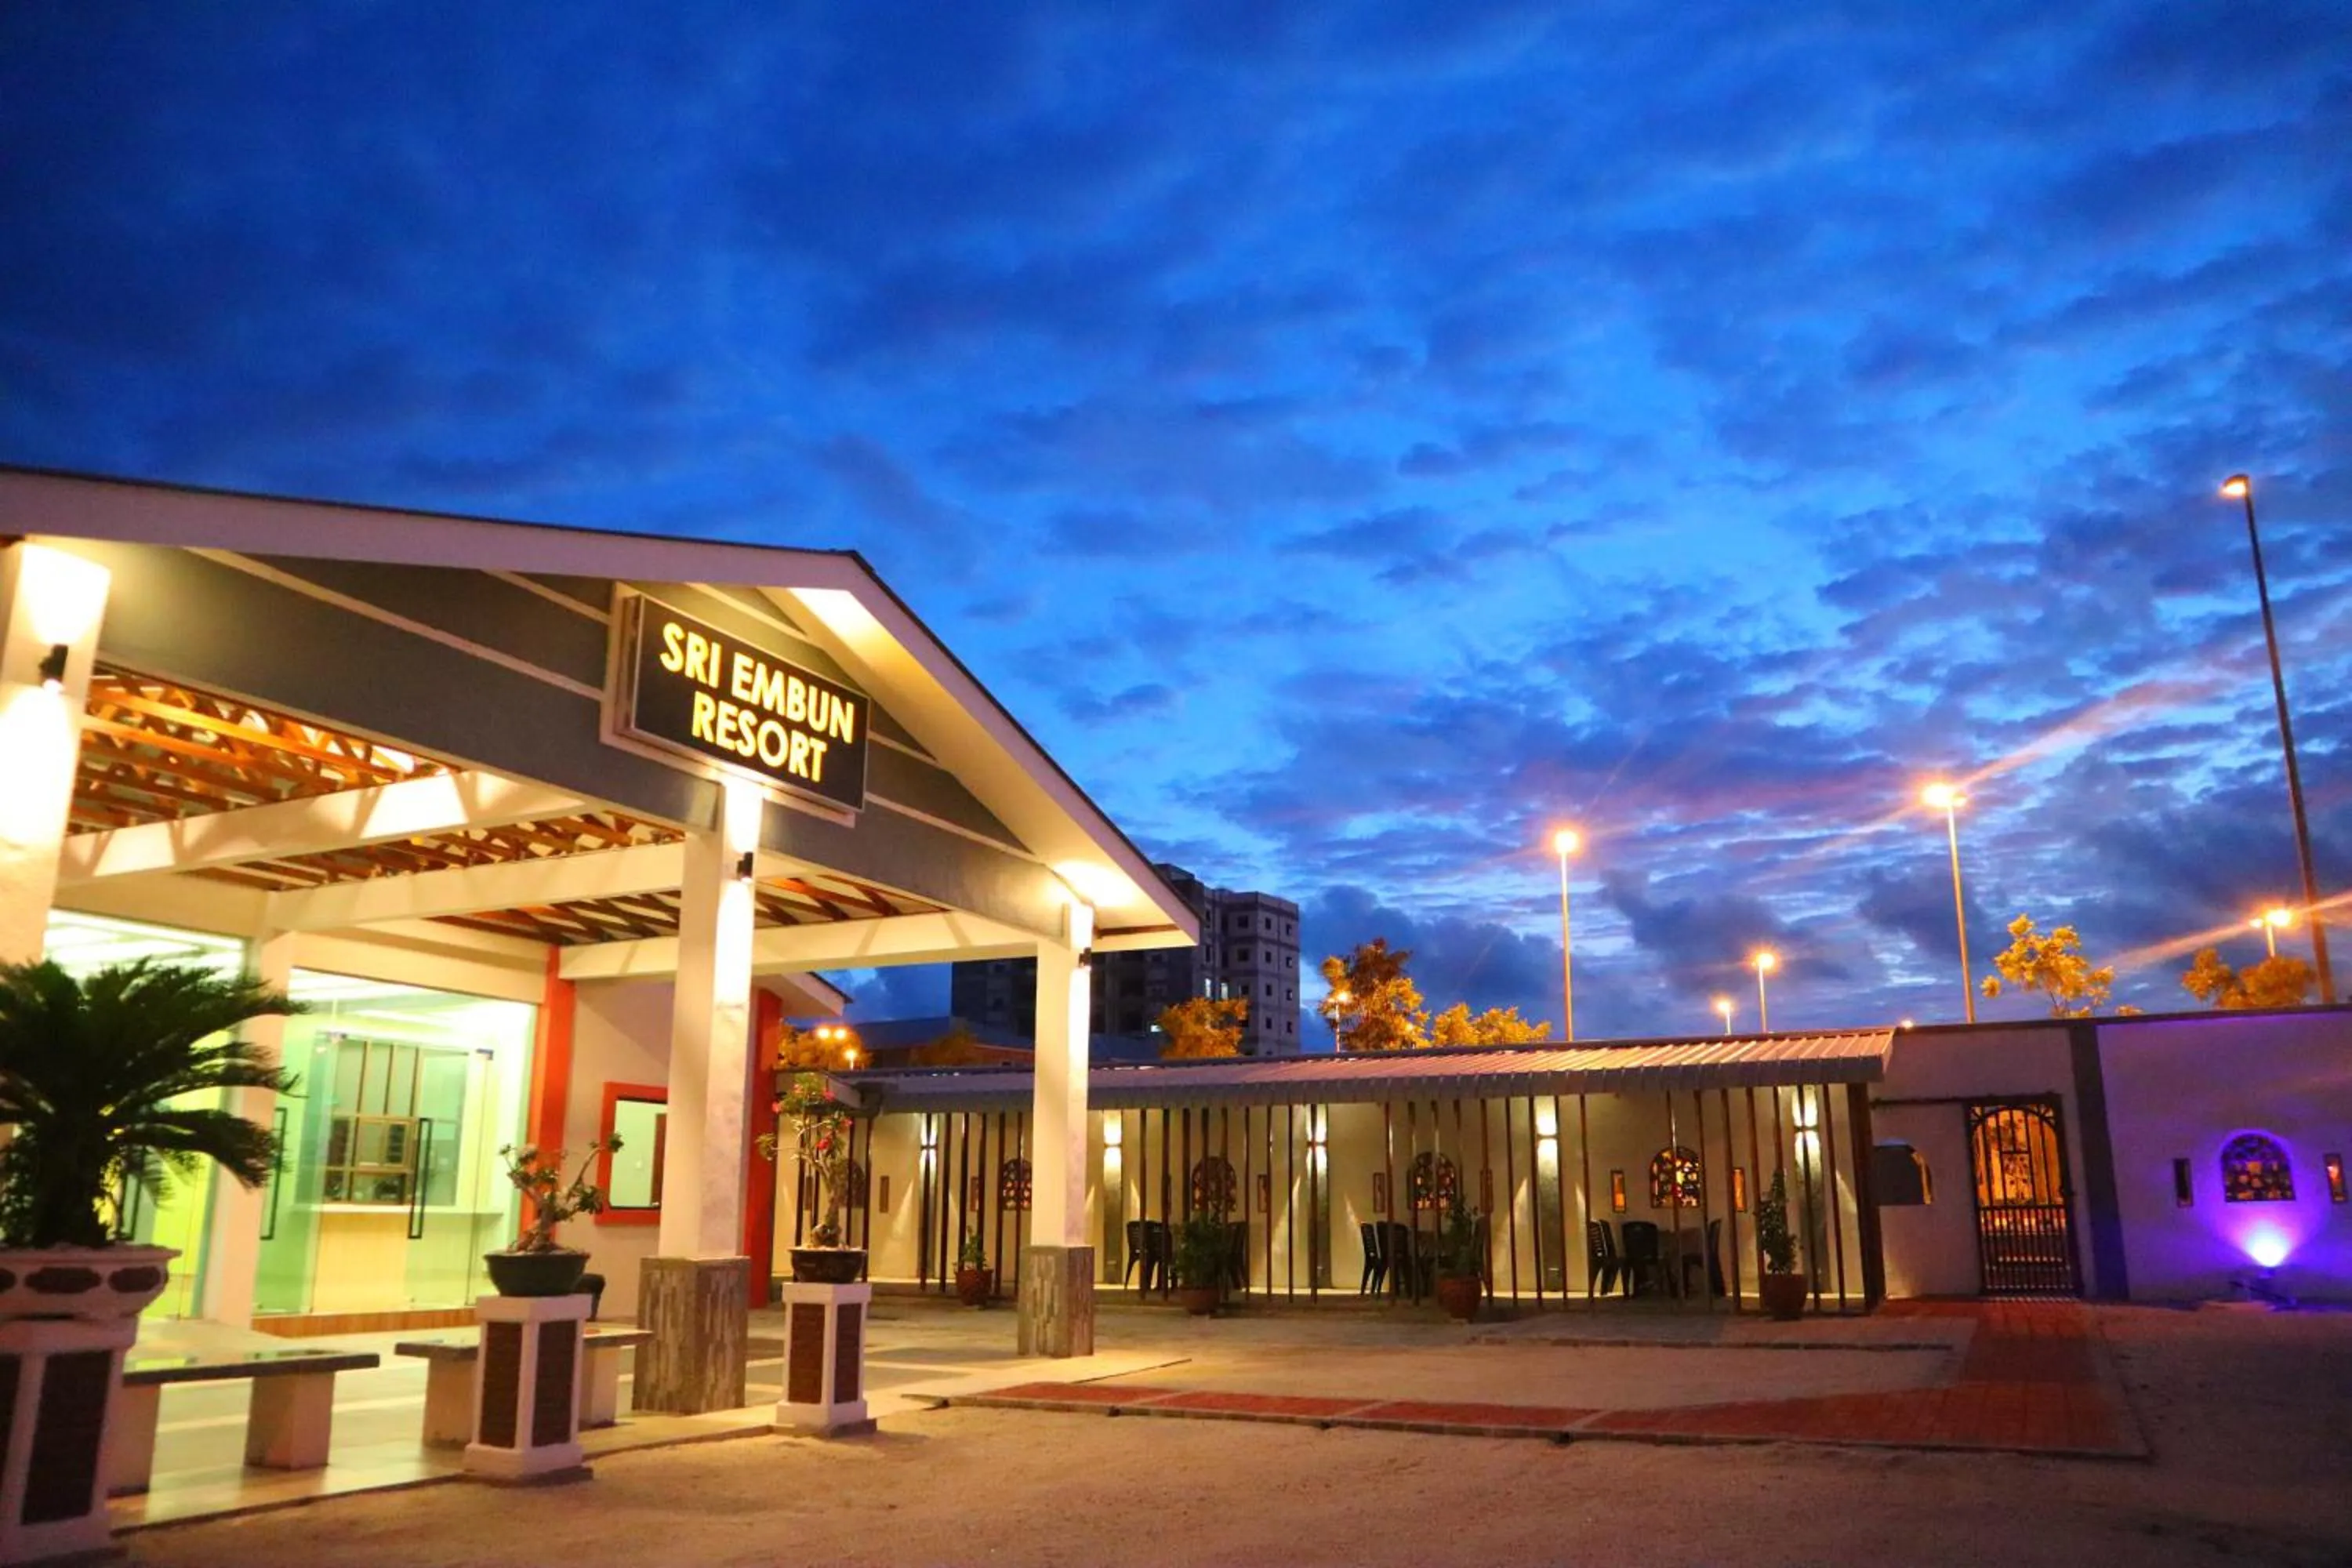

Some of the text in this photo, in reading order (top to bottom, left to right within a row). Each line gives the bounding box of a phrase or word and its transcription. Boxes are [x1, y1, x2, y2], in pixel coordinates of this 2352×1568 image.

[659, 622, 854, 744] SRI EMBUN
[691, 691, 827, 782] RESORT
